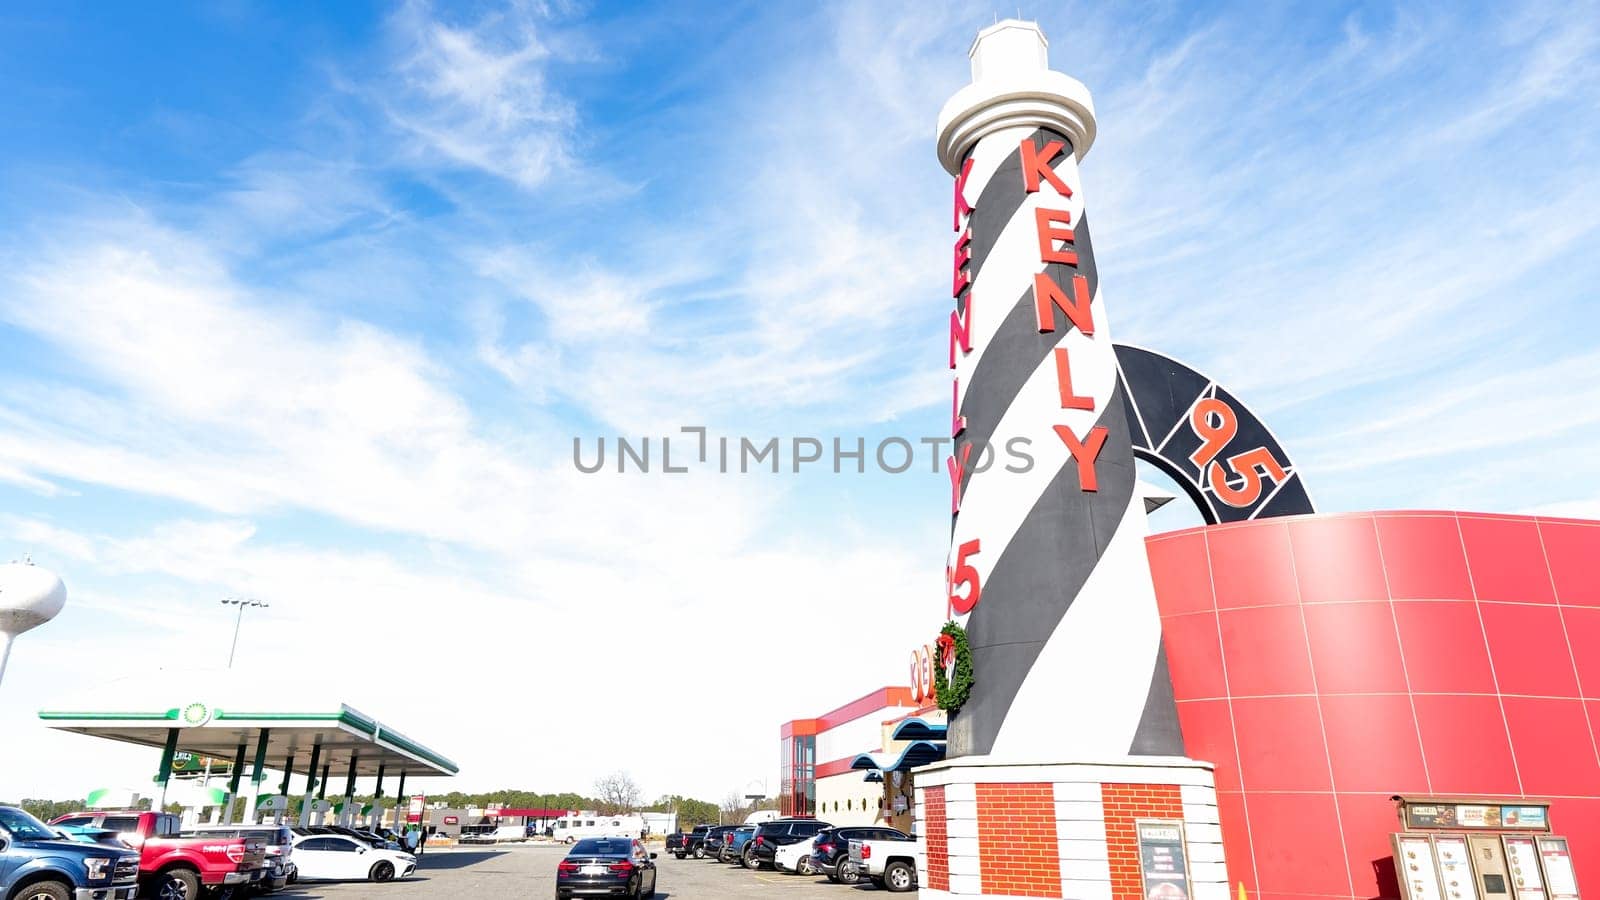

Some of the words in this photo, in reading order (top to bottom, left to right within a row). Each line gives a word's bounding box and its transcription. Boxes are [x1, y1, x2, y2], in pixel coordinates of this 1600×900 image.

[947, 157, 975, 515] KENLY
[1020, 138, 1109, 492] KENLY
[1188, 397, 1288, 508] 95
[945, 538, 981, 620] 5
